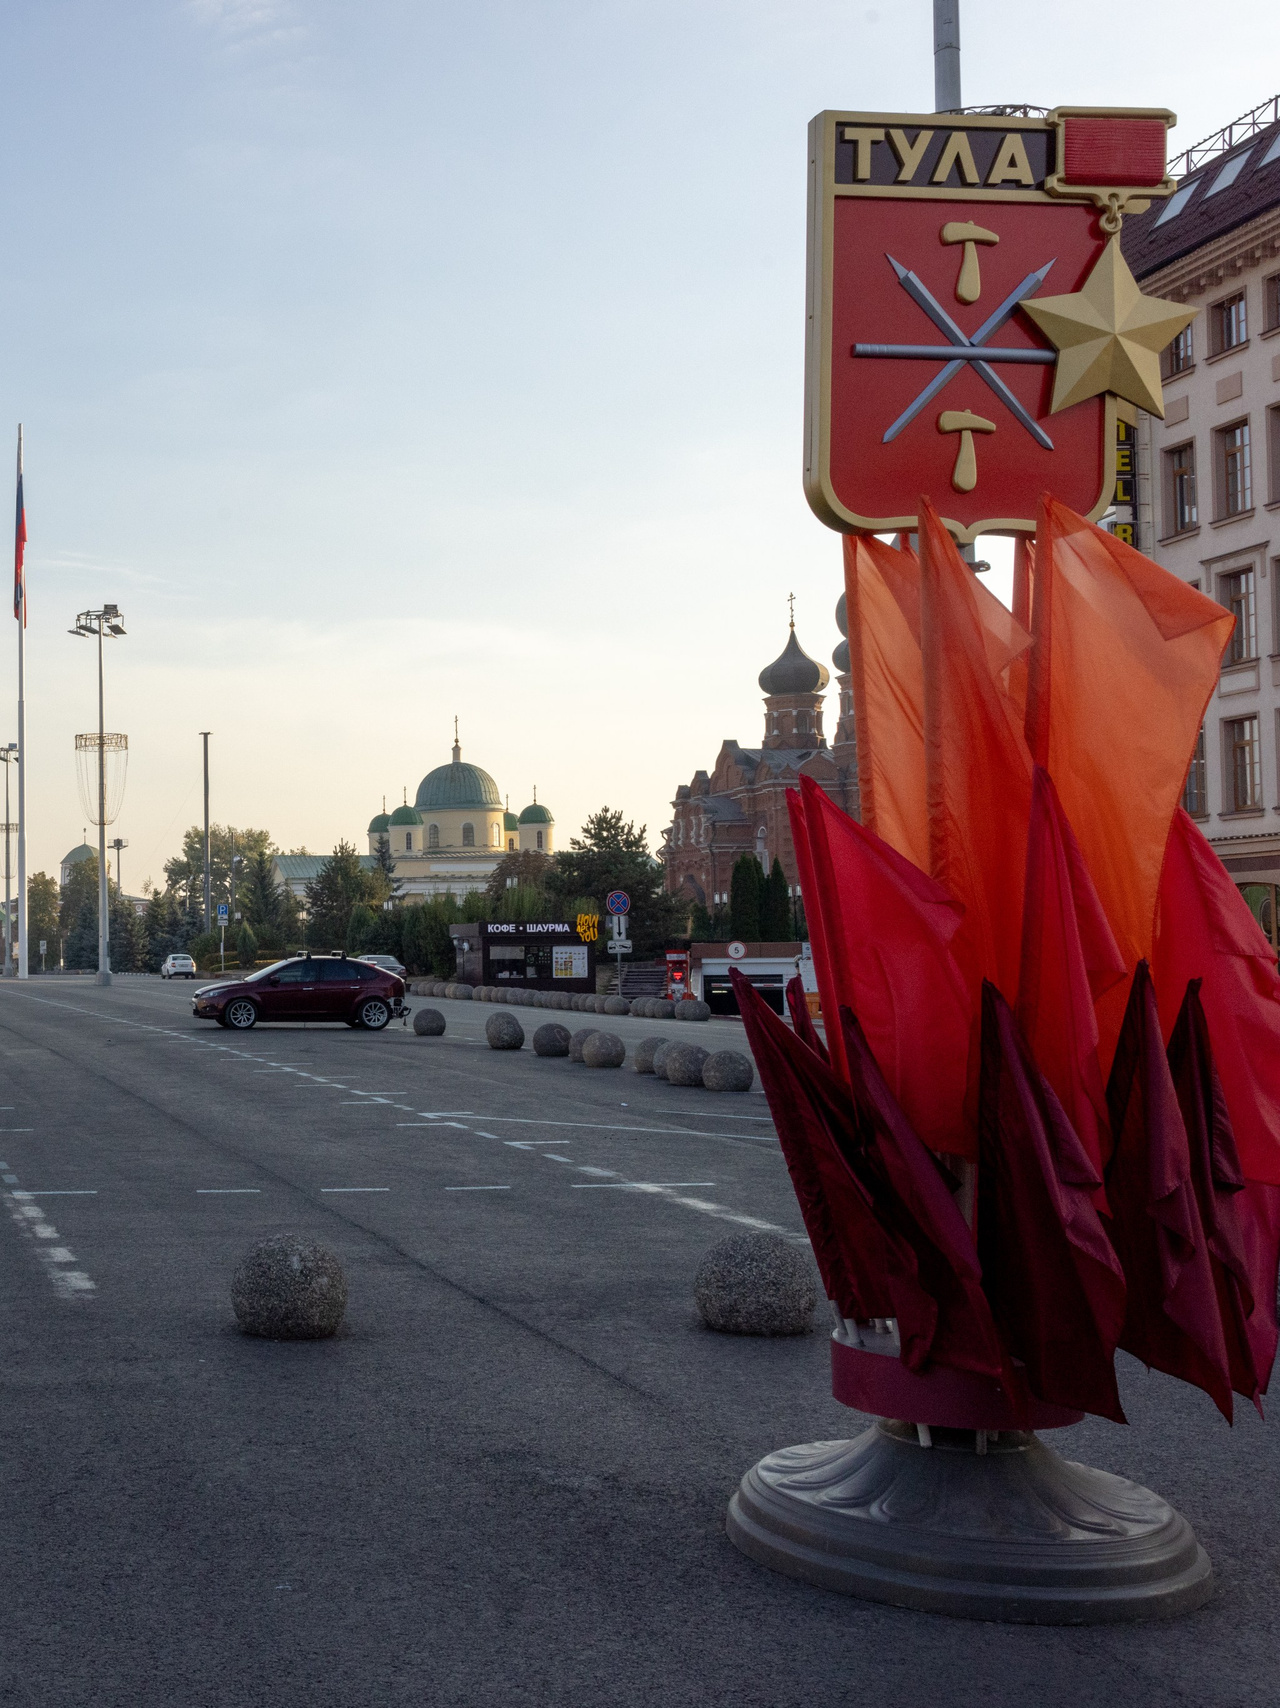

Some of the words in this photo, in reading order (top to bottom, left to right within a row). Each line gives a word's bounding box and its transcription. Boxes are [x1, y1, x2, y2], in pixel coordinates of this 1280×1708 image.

[841, 127, 1035, 186] ТУЛА
[576, 913, 599, 927] HOW
[487, 924, 516, 933] КОФЕ
[526, 923, 571, 933] ШАУРМА
[580, 927, 598, 942] YOU
